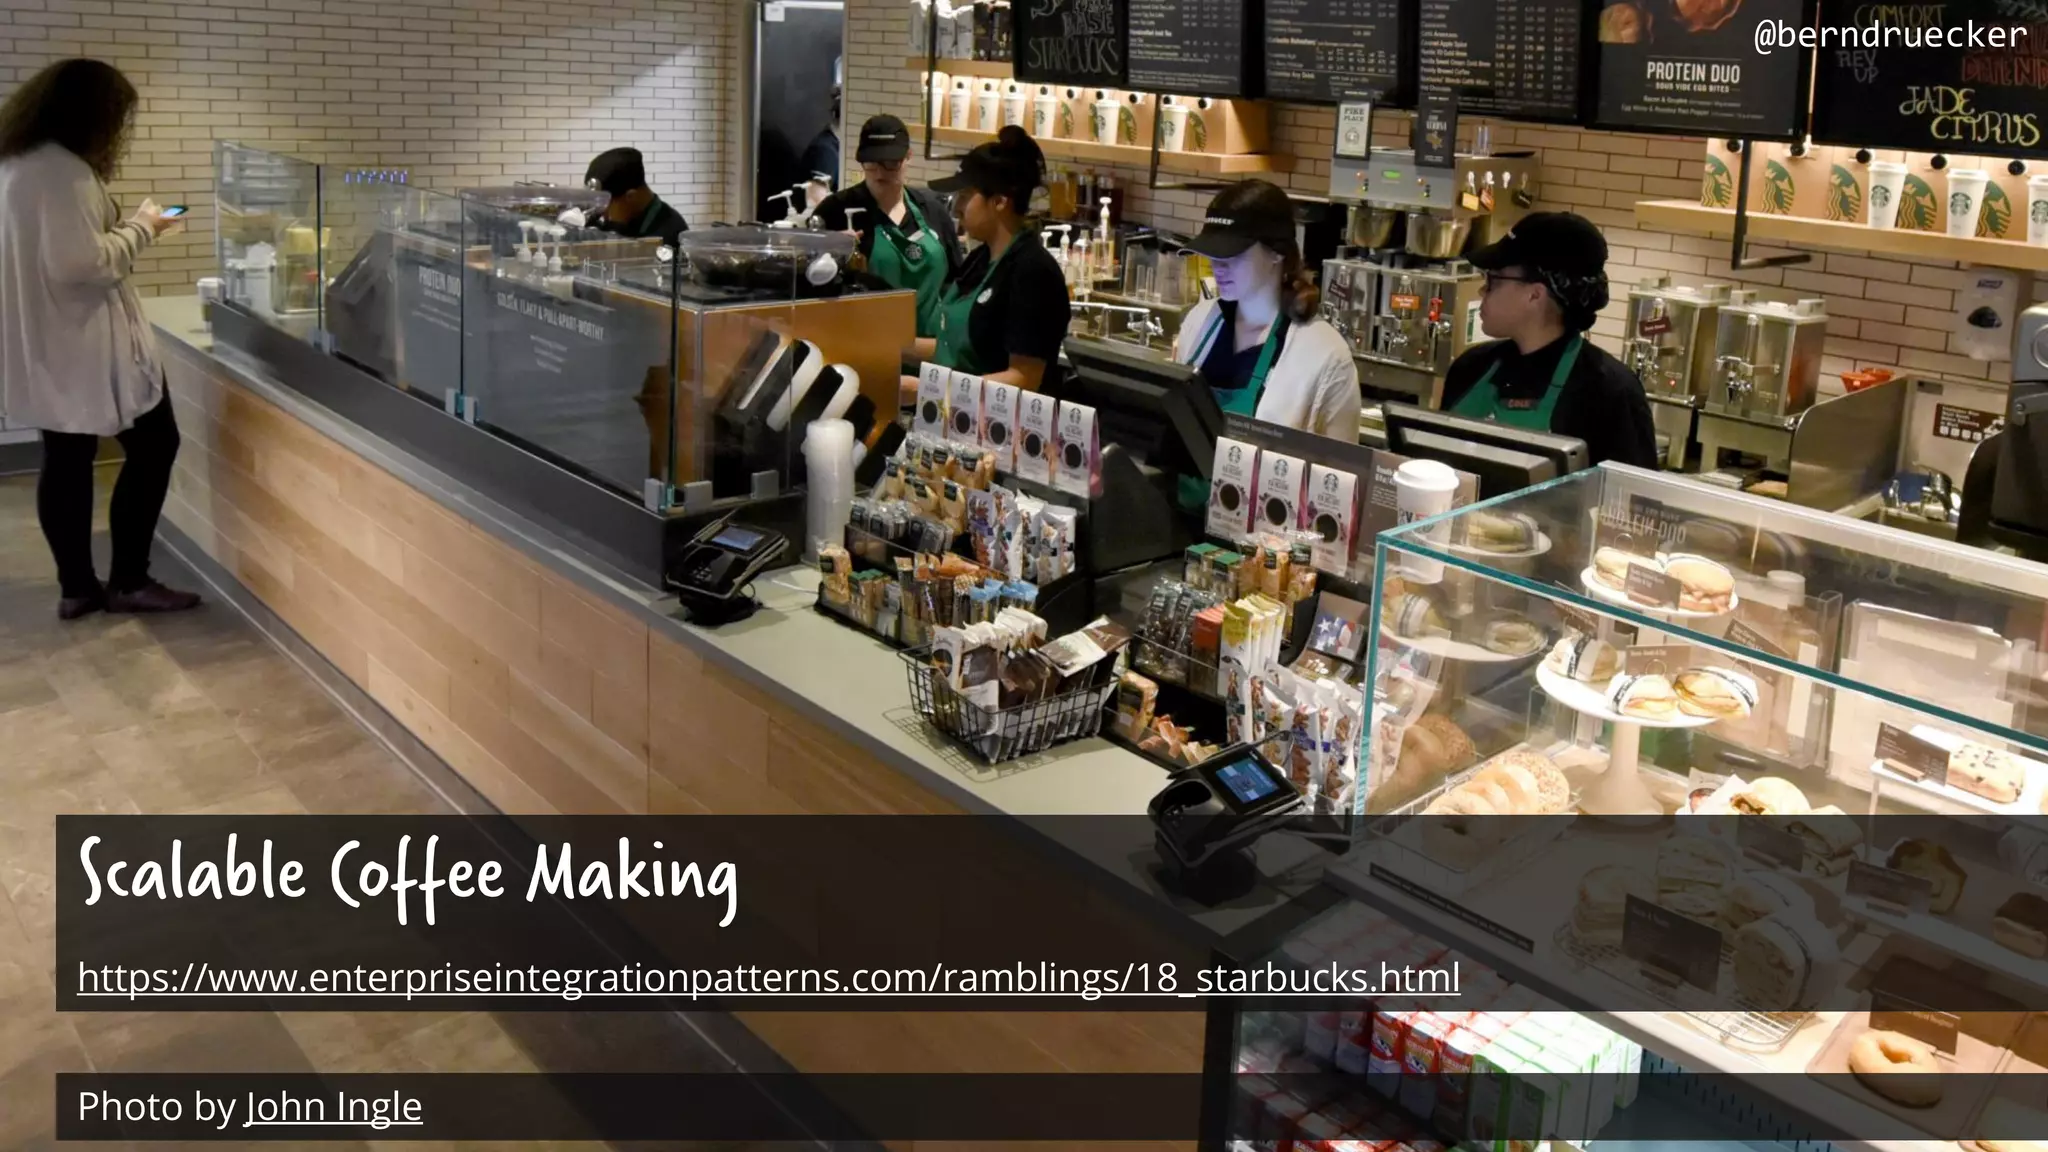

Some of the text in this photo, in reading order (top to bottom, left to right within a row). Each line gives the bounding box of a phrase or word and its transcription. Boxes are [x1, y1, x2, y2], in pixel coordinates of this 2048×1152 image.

[1647, 61, 1741, 84] PROTEIN DUO
[1344, 106, 1365, 115] PIKE
[1899, 85, 1976, 115] JADE
[1930, 111, 2041, 146] CITRUS
